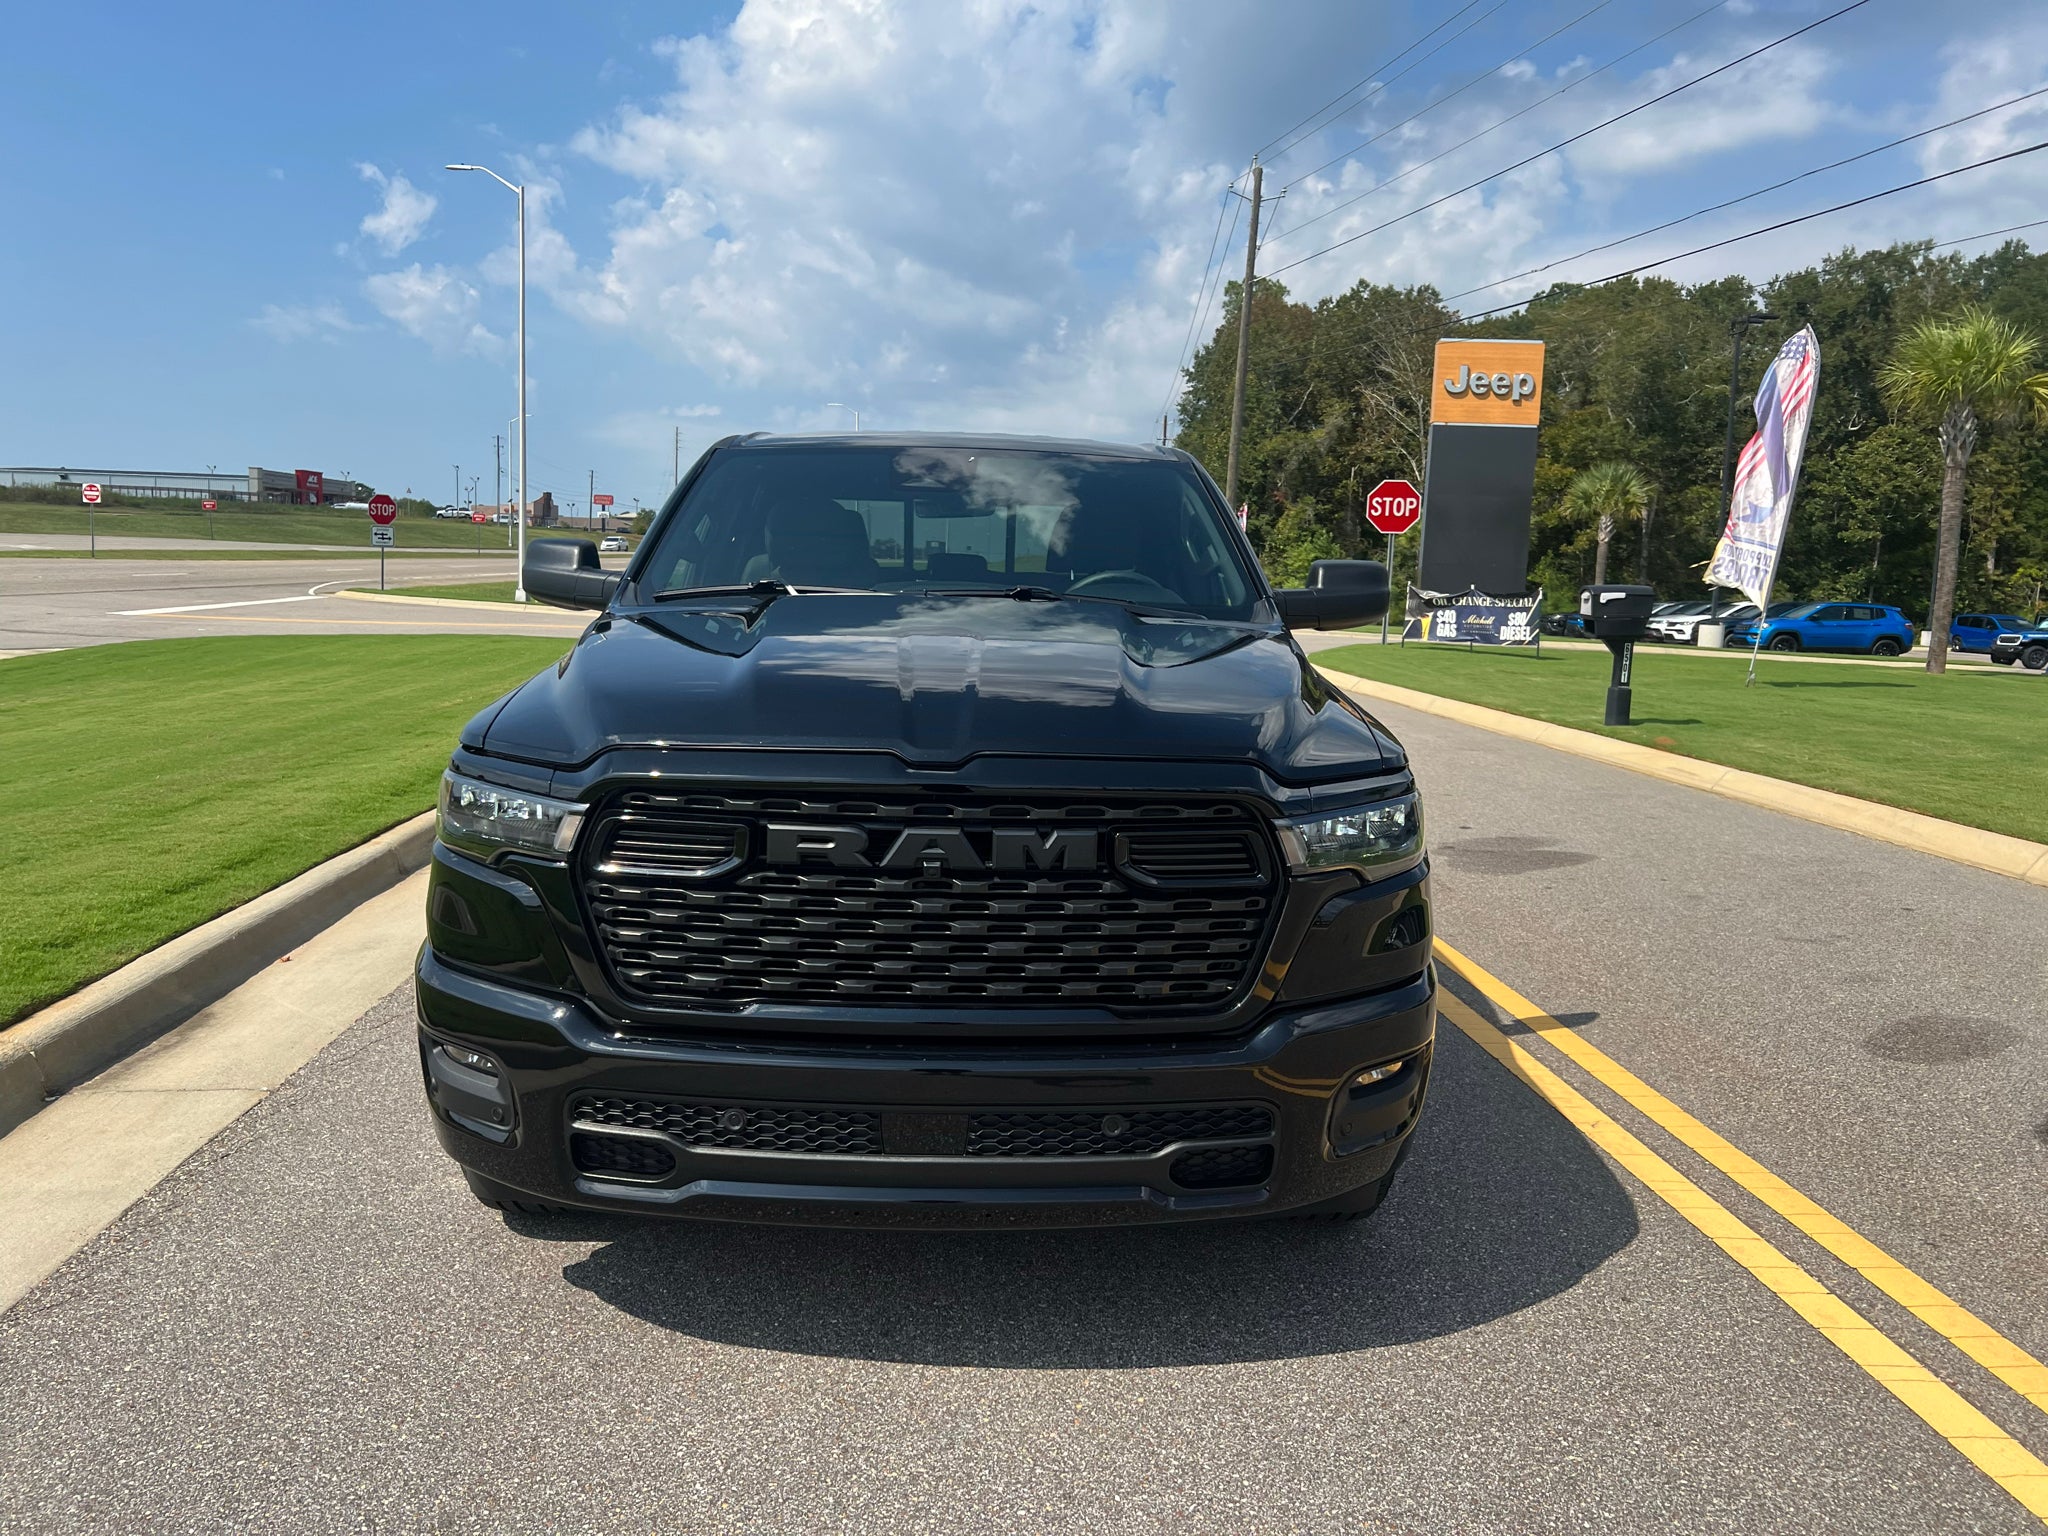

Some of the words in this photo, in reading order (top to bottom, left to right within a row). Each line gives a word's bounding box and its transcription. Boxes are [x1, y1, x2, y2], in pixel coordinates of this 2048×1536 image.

[1443, 365, 1535, 400] Jeep
[370, 503, 395, 516] STOP
[1370, 497, 1418, 517] STOP
[1452, 596, 1493, 607] CHANGE
[1494, 597, 1534, 608] SPECIAL
[1436, 610, 1457, 624] $40
[1507, 611, 1527, 626] $80
[1436, 623, 1457, 638] GAS
[1499, 626, 1532, 641] DIESEL
[1622, 644, 1630, 682] 6501
[766, 823, 1098, 870] RAM
